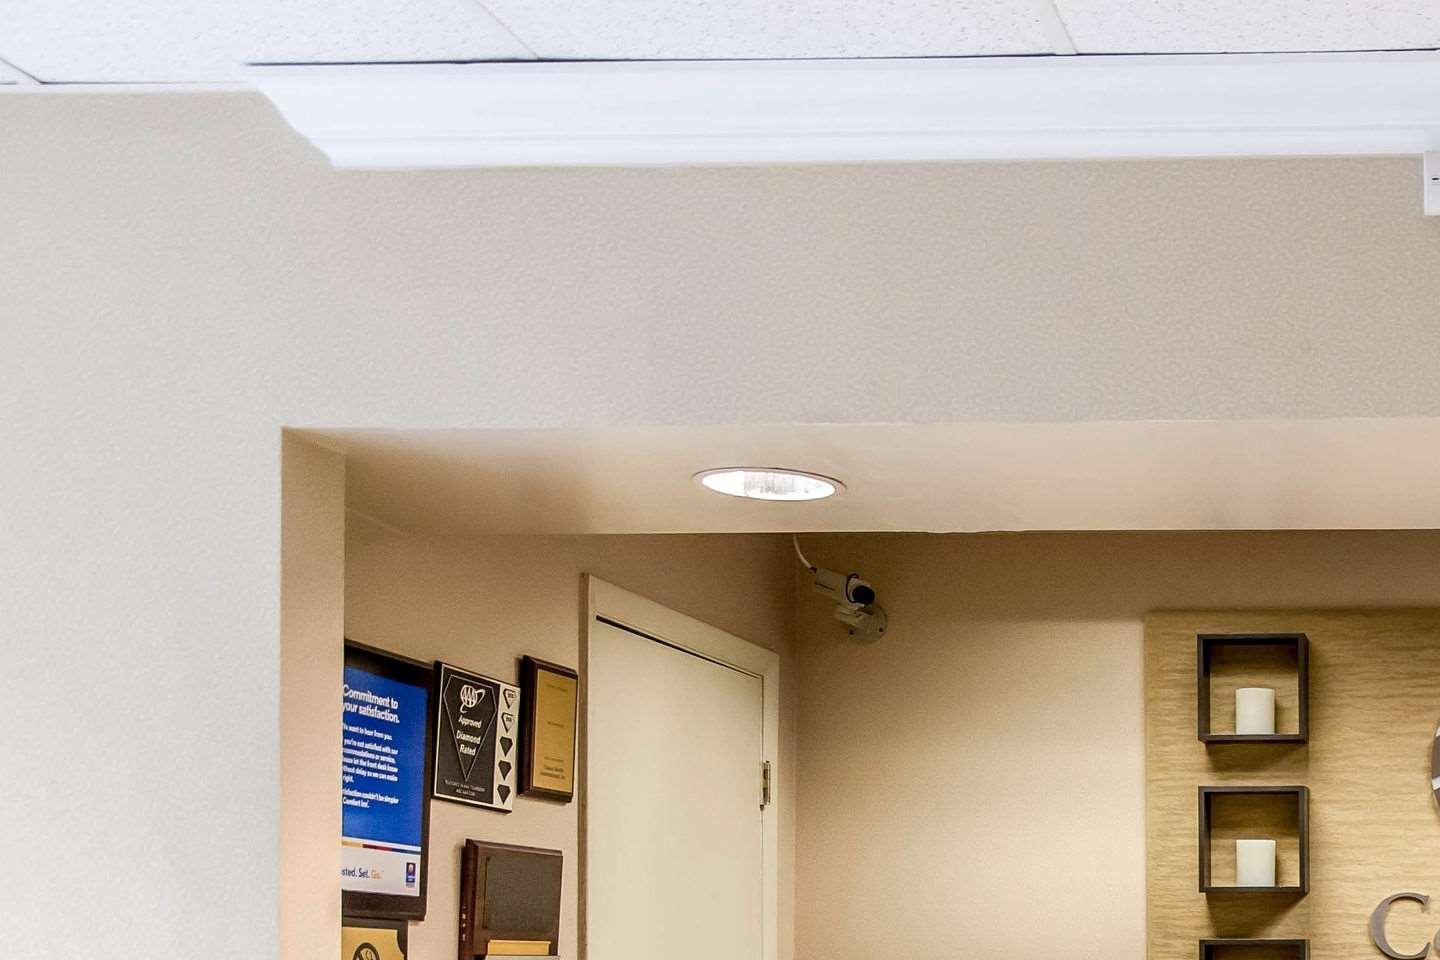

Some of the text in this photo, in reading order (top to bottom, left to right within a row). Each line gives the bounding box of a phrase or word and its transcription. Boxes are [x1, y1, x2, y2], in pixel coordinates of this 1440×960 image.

[343, 684, 398, 710] Commitment to
[358, 705, 400, 724] satisfaction.
[458, 715, 482, 729] Approved
[456, 730, 481, 744] Diamond
[460, 744, 477, 756] Rated
